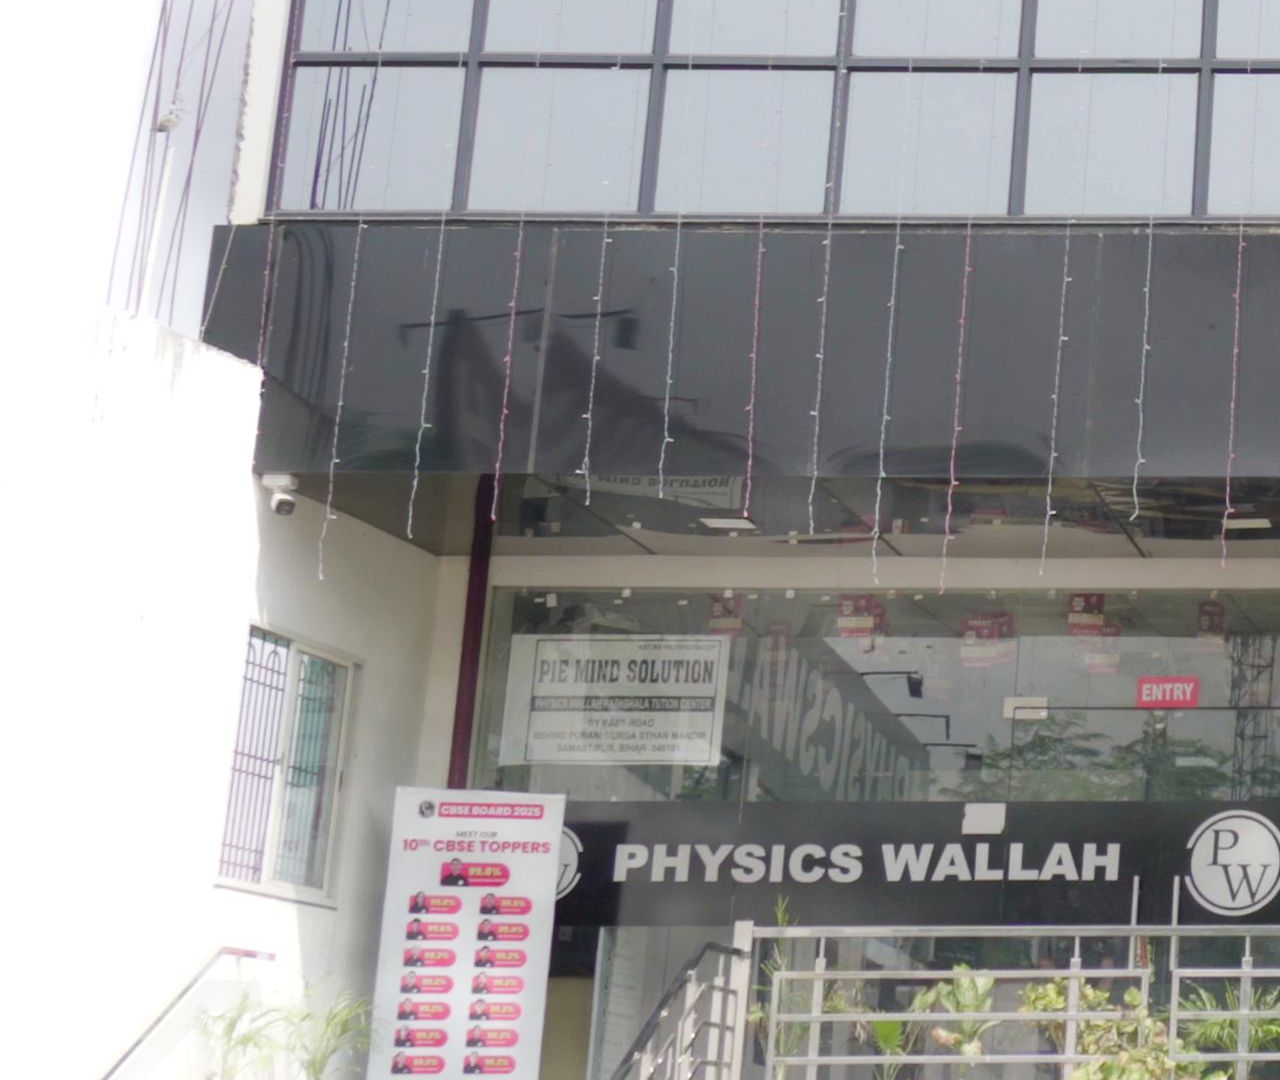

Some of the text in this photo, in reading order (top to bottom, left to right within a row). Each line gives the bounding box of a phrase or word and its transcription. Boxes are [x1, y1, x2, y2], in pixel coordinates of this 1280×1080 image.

[538, 659, 714, 684] PIE MIND SOLUTION
[1142, 683, 1194, 702] ENTRY
[471, 805, 512, 817] BOARD
[434, 840, 475, 852] CBSE
[479, 841, 552, 854] TOPPERS
[613, 842, 1120, 884] PHYSICS WALLAH
